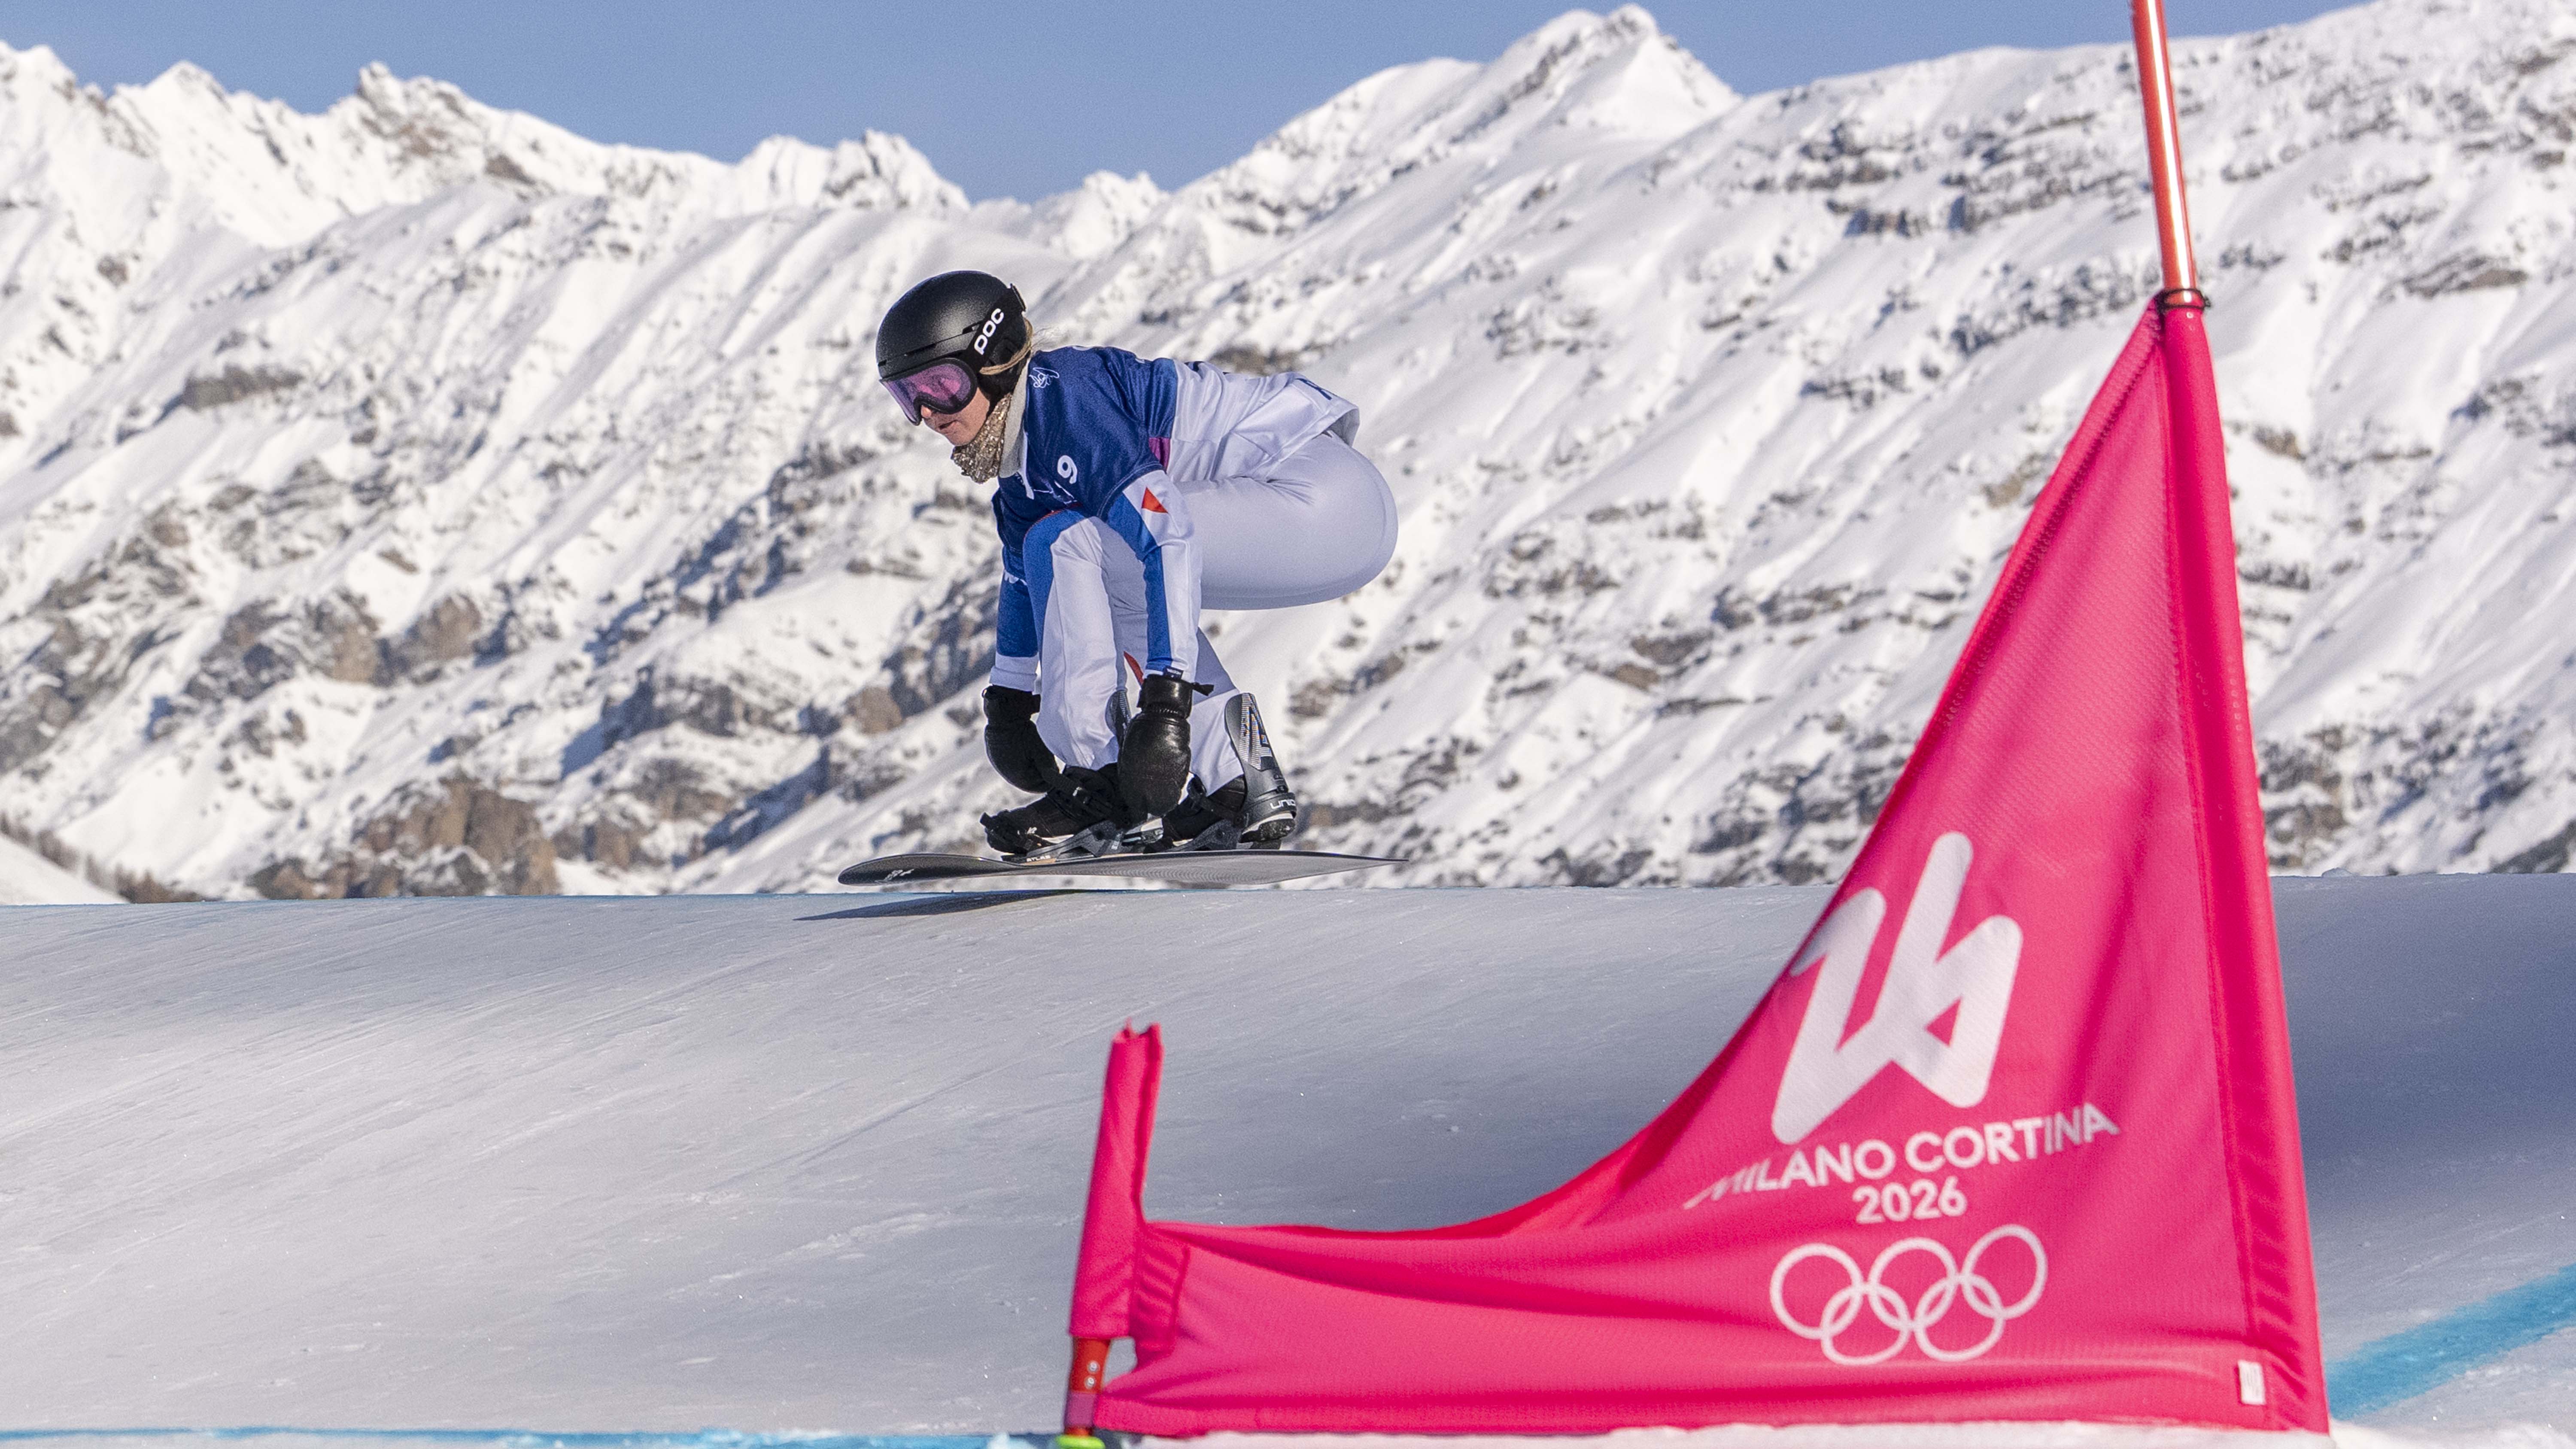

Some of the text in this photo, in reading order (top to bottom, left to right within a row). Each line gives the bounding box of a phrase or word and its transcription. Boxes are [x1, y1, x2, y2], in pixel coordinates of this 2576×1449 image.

[974, 308, 1004, 355] POC
[1057, 455, 1078, 484] 9
[1683, 1102, 2121, 1210] MILANO CORTINA
[1852, 1175, 1968, 1224] 2026
